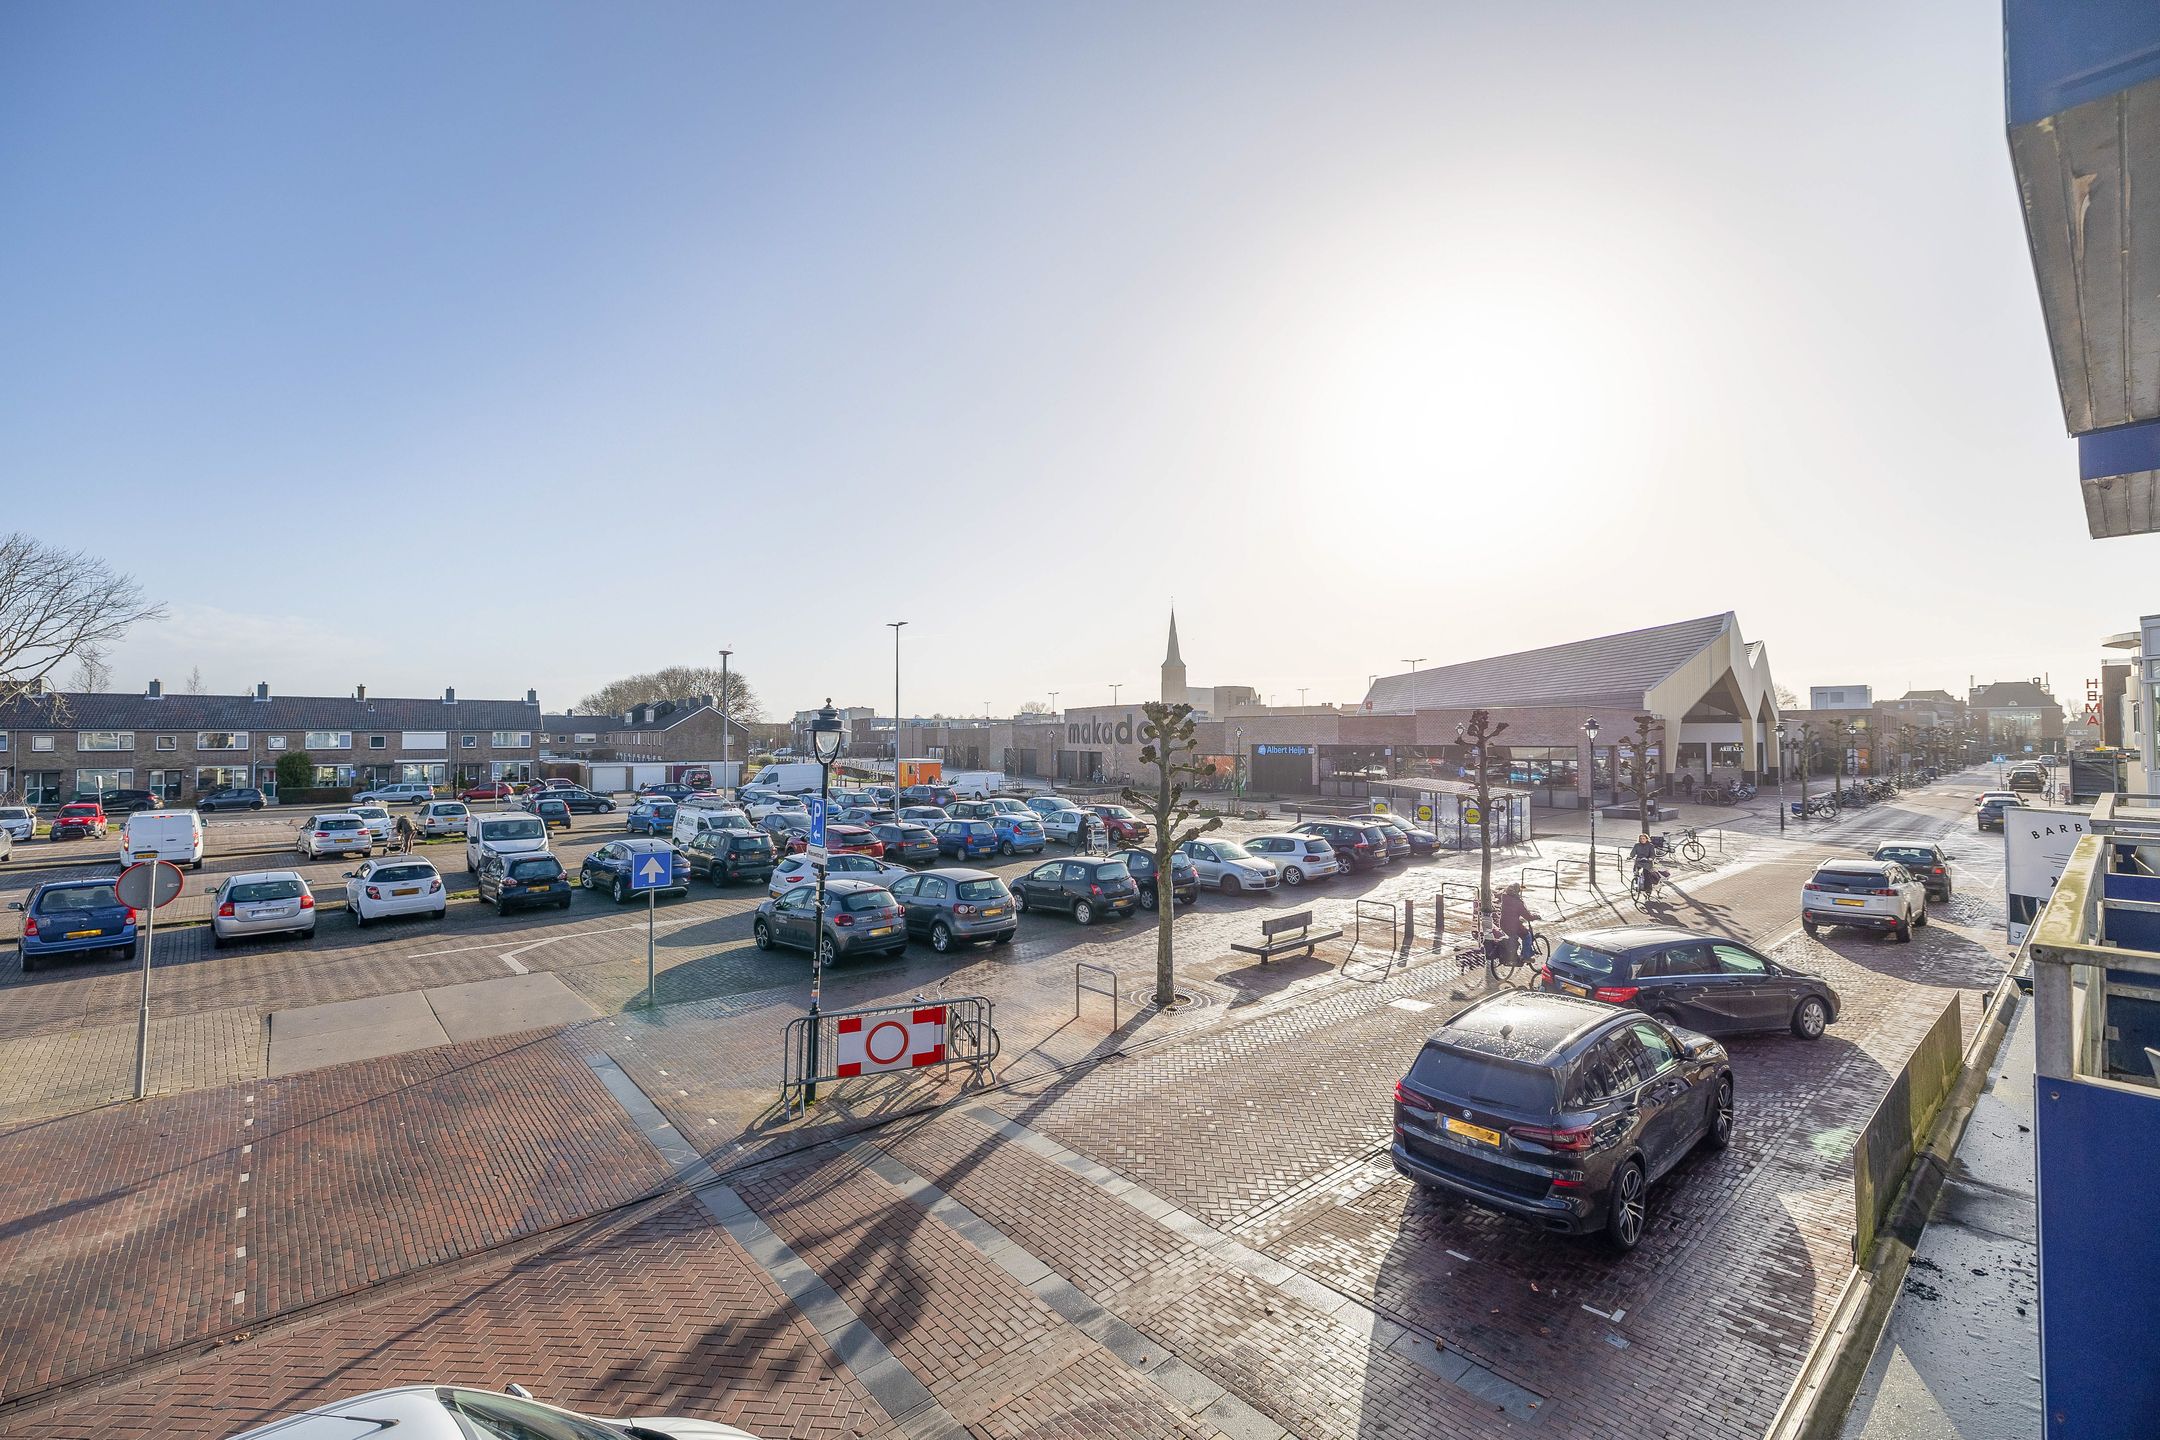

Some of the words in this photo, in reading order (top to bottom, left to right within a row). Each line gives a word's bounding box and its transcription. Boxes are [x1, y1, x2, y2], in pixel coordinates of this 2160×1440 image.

[1266, 746, 1288, 754] Albert
[1288, 746, 1306, 756] Heijn
[813, 802, 821, 826] P
